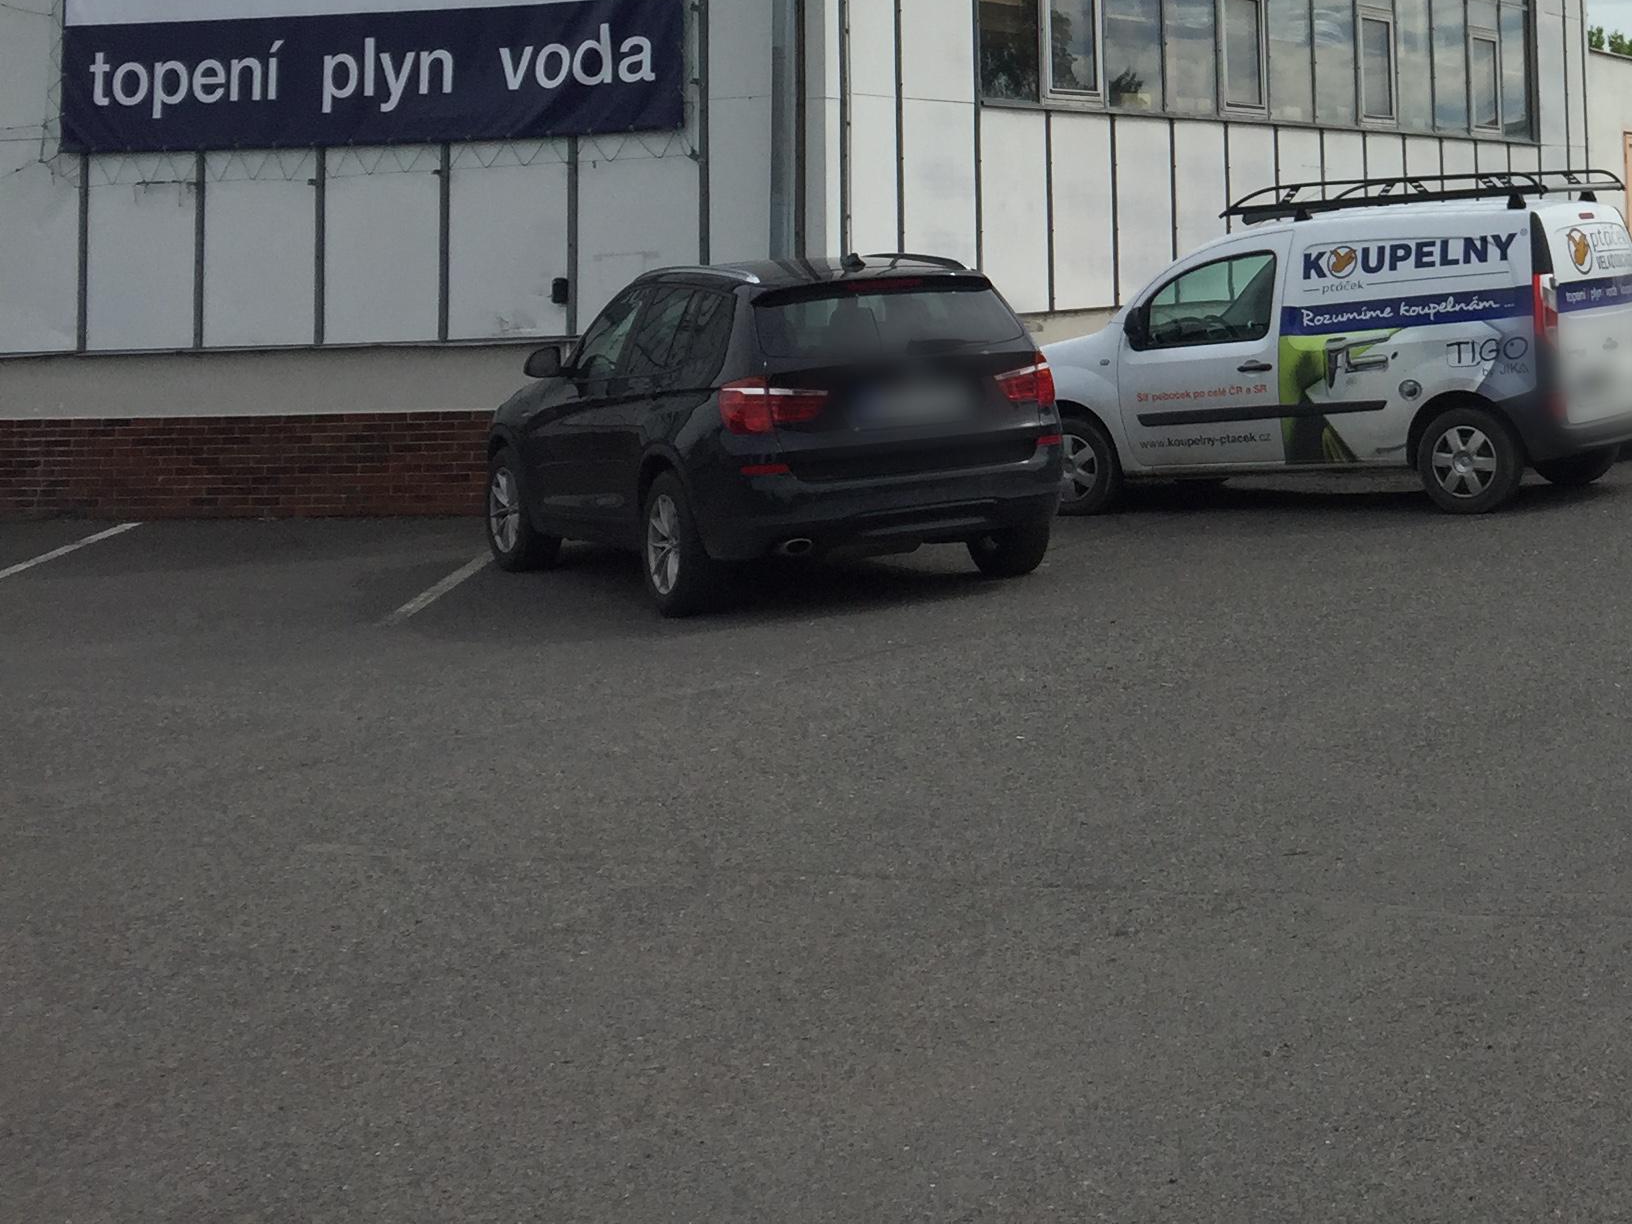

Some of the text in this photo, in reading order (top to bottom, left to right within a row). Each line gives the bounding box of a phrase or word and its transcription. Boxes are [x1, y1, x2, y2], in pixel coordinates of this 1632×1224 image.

[89, 23, 656, 119] topení plyn voda
[1301, 305, 1394, 327] Rozumíme
[1446, 336, 1529, 364] TIGO
